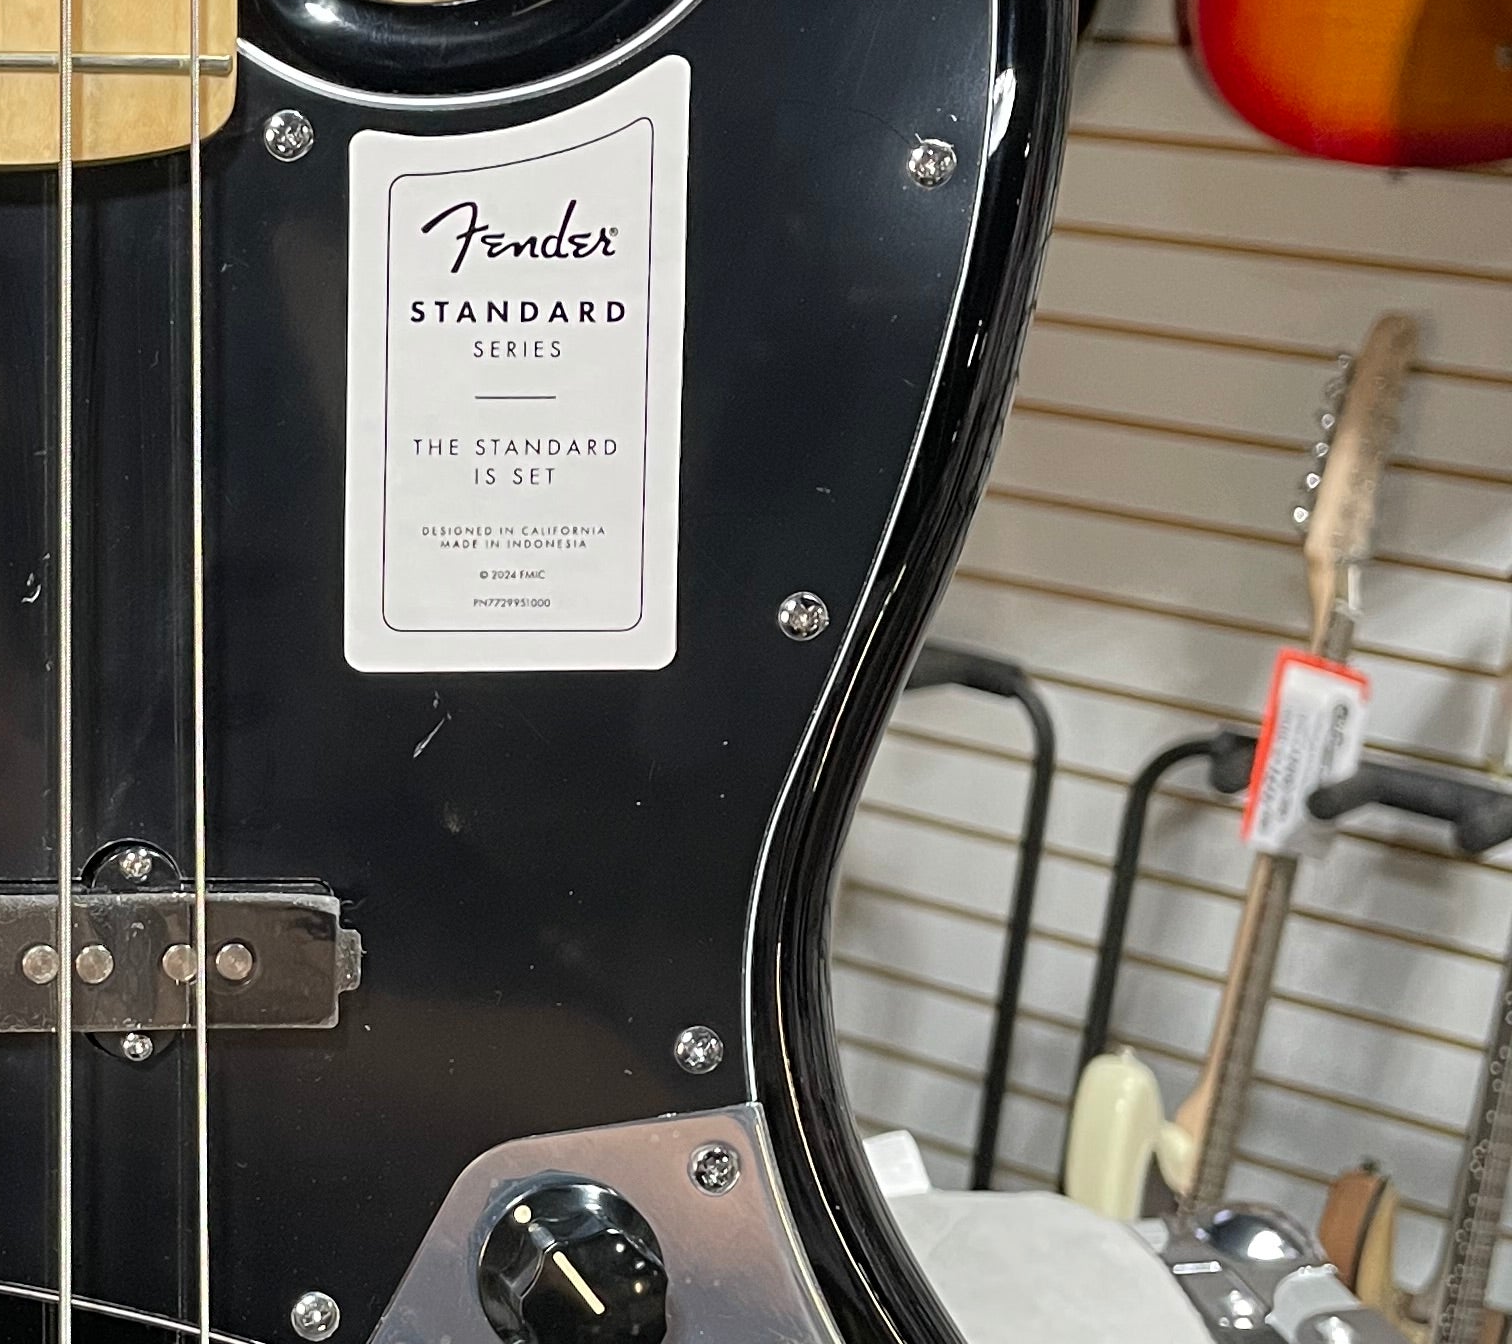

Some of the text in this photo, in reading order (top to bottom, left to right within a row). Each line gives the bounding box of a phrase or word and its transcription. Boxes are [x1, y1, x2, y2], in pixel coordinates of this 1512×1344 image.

[410, 300, 626, 323] STANDARD
[473, 341, 561, 358] SERIES
[413, 438, 618, 456] THE STANDARD
[474, 467, 556, 485] IS SET
[422, 525, 607, 537] DESIGNED IN CALIFORNIA
[439, 539, 588, 549] MADE IN INDONESIA
[491, 569, 517, 580] 2024
[519, 569, 546, 580] FMIC
